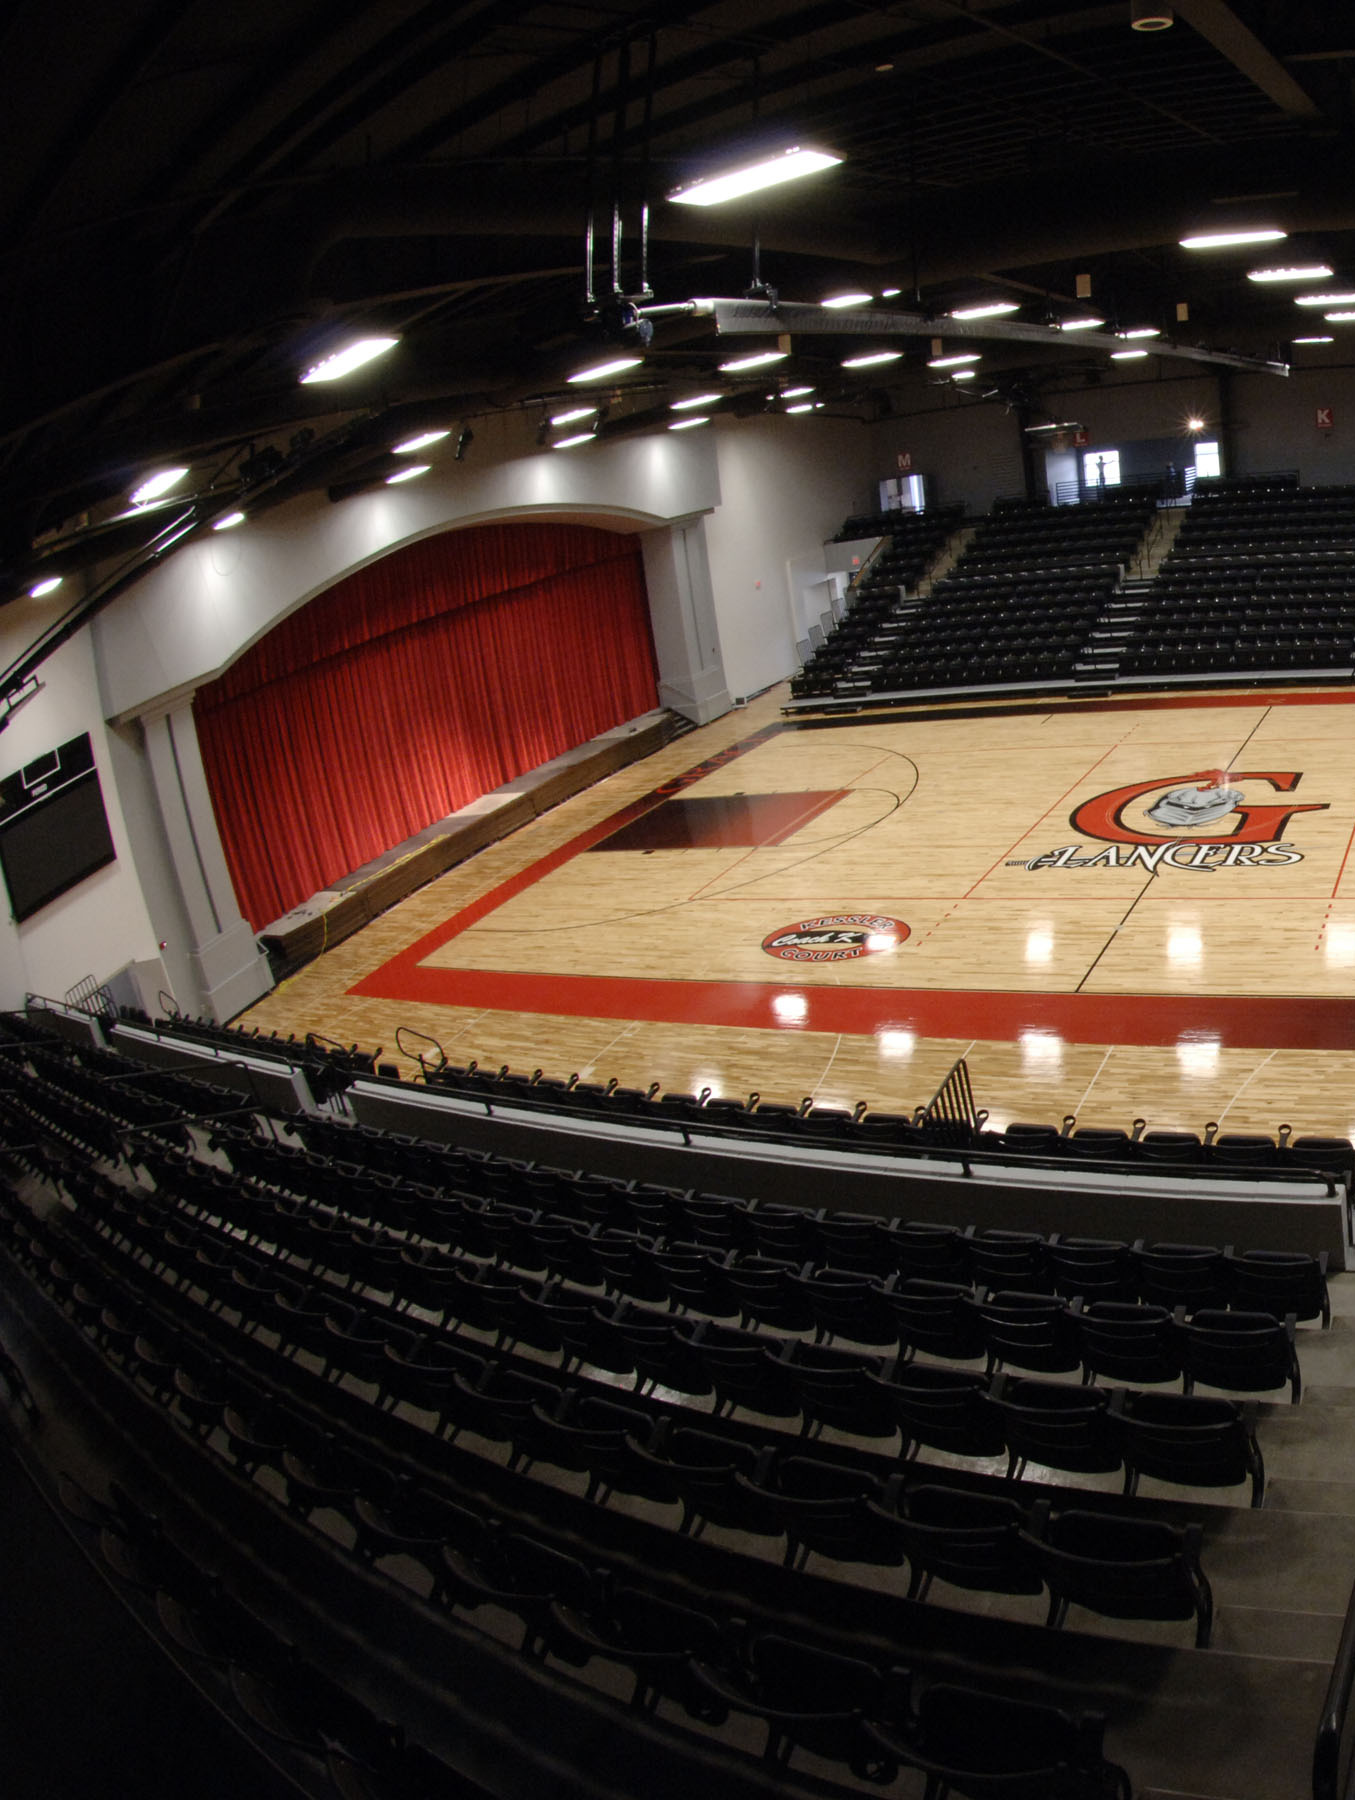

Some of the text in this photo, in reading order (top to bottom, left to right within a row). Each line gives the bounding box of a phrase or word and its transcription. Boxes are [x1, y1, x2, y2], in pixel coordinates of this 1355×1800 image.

[1316, 409, 1331, 424] K
[1075, 432, 1086, 443] L
[897, 453, 911, 468] M
[1069, 770, 1331, 846] G
[1047, 842, 1305, 876] LANCERS
[799, 915, 896, 931] KESSLER
[771, 931, 863, 947] Coach K
[780, 947, 864, 962] COURT
